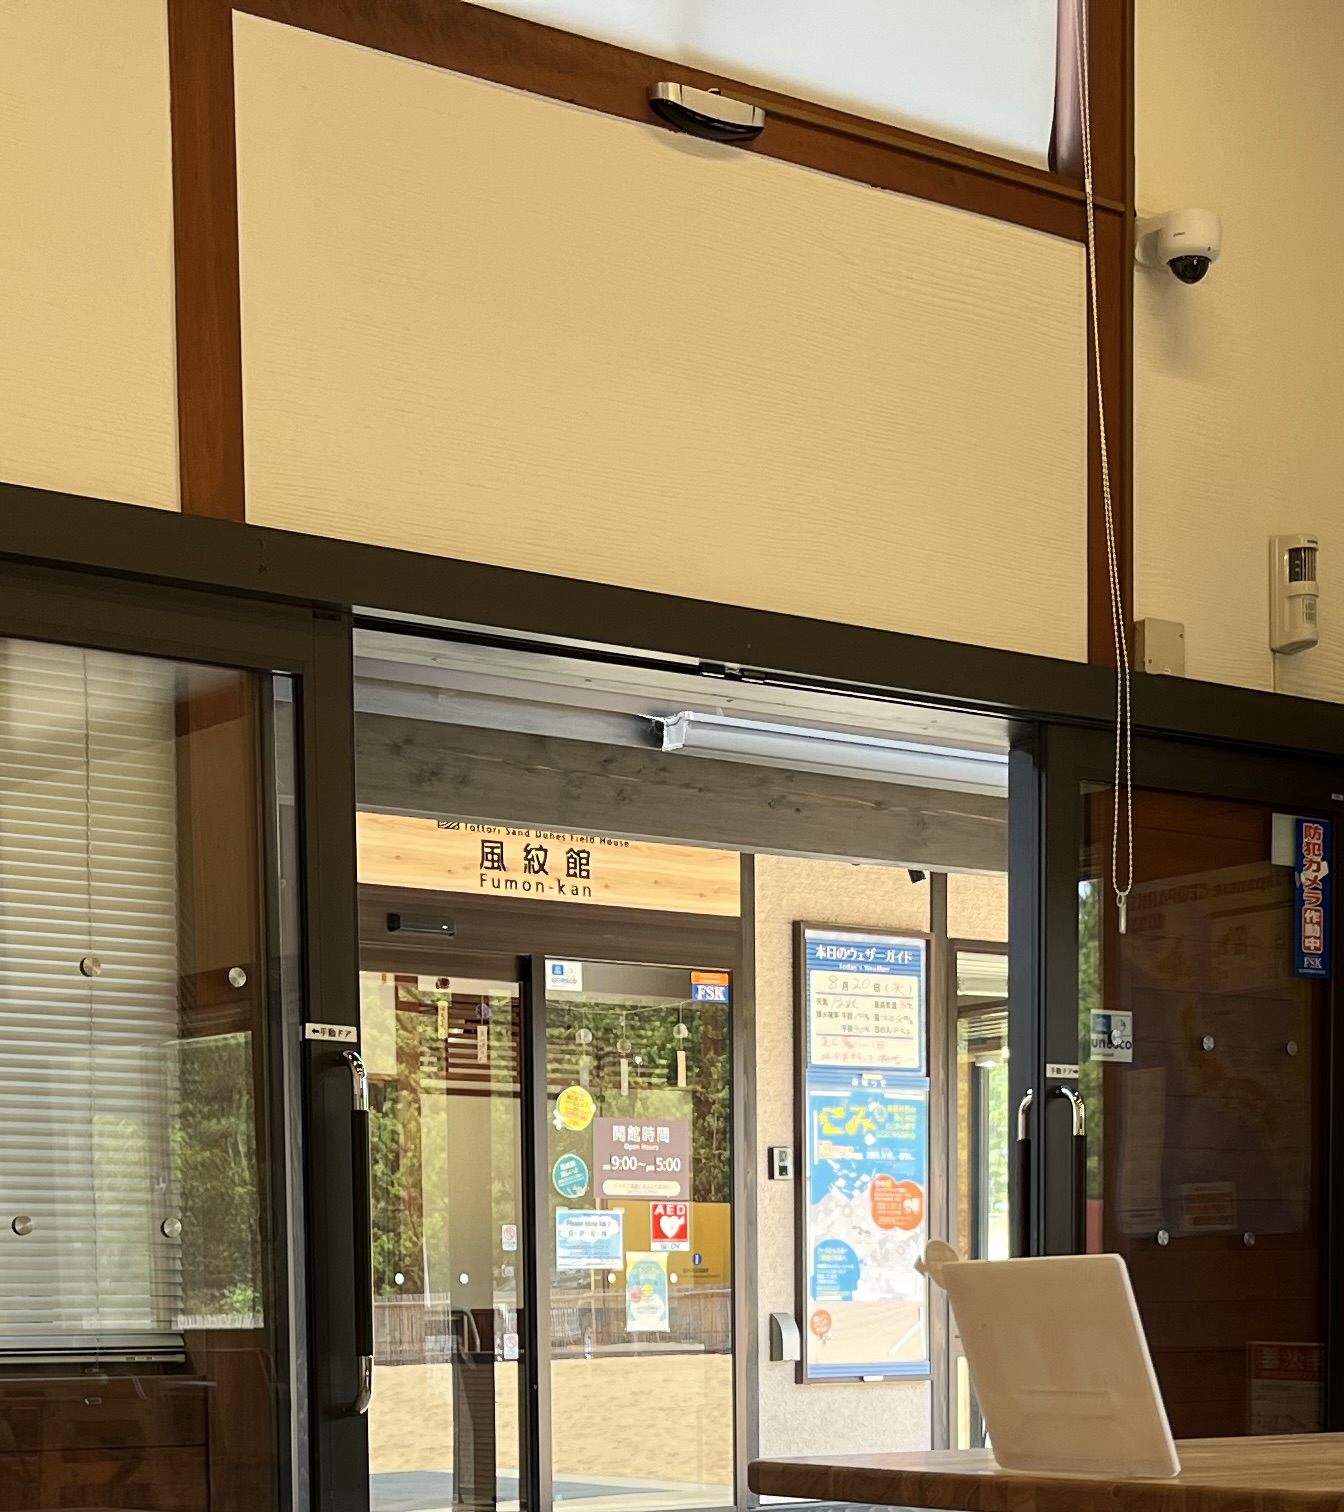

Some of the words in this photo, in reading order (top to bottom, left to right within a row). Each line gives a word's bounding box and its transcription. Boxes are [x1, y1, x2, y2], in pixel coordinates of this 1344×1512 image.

[505, 827, 530, 838] Sand
[599, 837, 630, 848] House
[479, 839, 591, 879] 風紋館
[479, 873, 592, 897] Fumon-kan
[816, 944, 913, 964] 本日のウェザーガイド
[1303, 957, 1322, 969] FSK
[697, 985, 726, 1000] FSK
[320, 1027, 352, 1037] 手動ドア
[612, 1125, 670, 1143] 開館時間
[654, 1205, 685, 1215] AED
